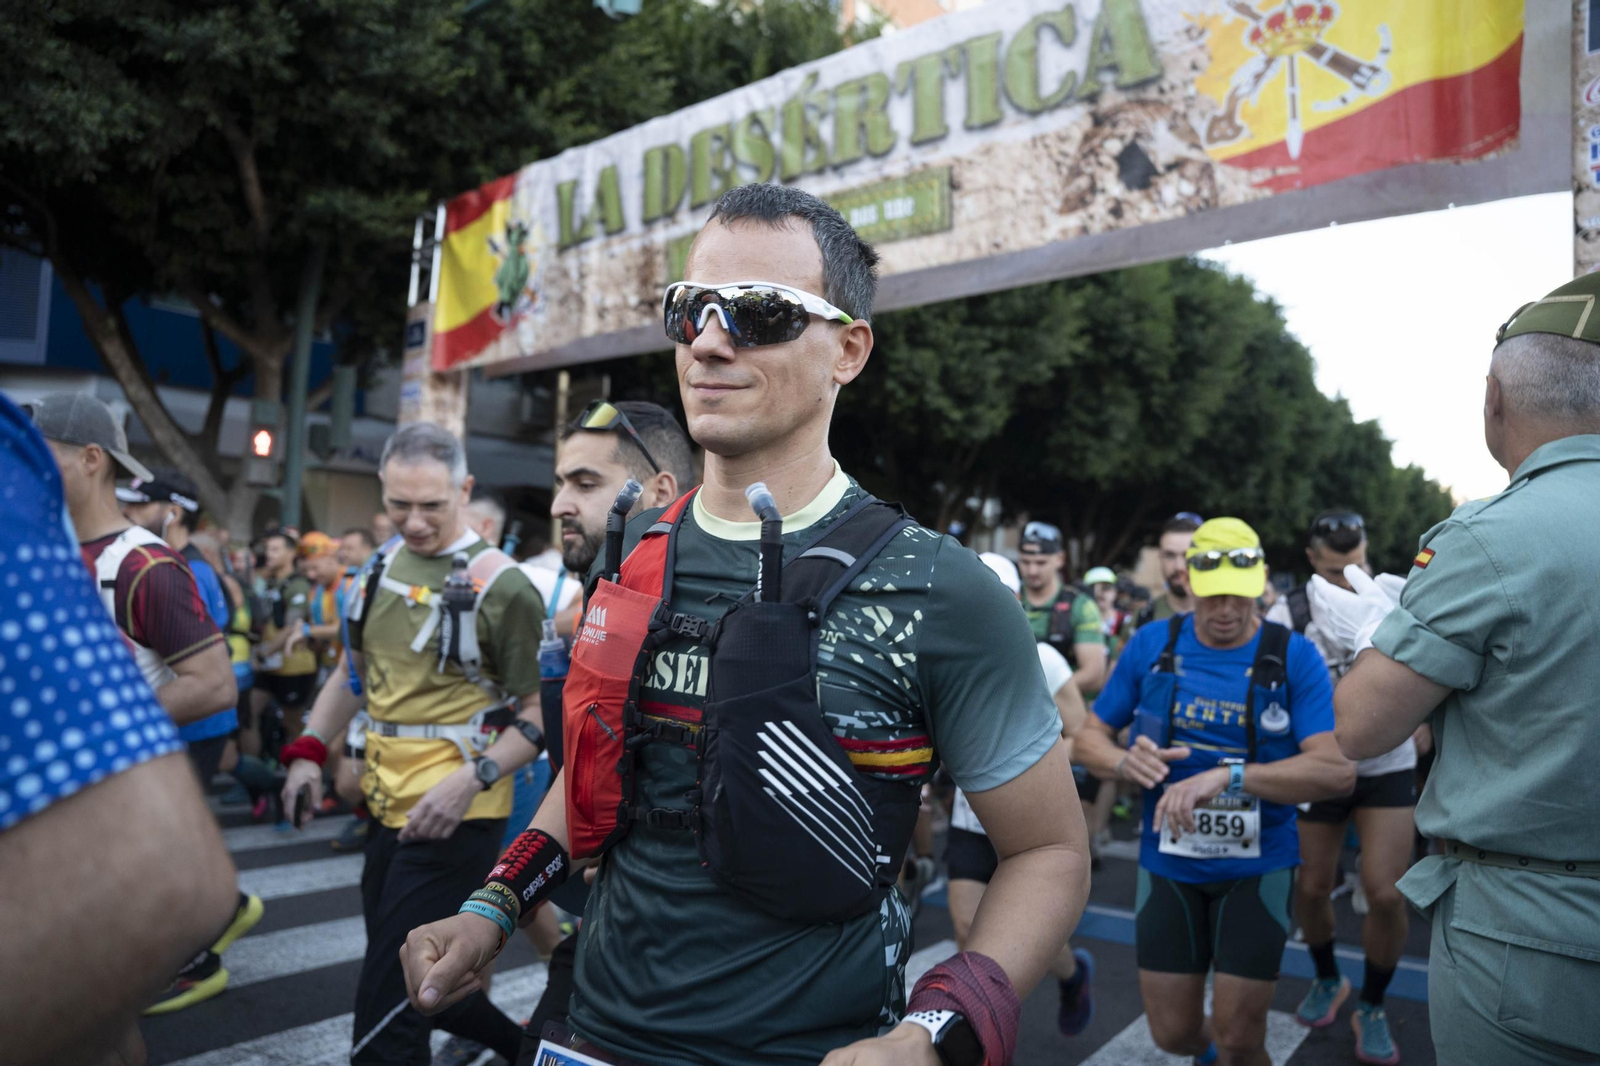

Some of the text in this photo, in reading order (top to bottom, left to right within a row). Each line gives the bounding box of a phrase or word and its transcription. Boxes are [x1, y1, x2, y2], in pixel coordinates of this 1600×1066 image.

[556, 0, 1163, 252] LA DESÉRTICA
[582, 625, 607, 642] ONIJIE
[1193, 812, 1245, 837] 859
